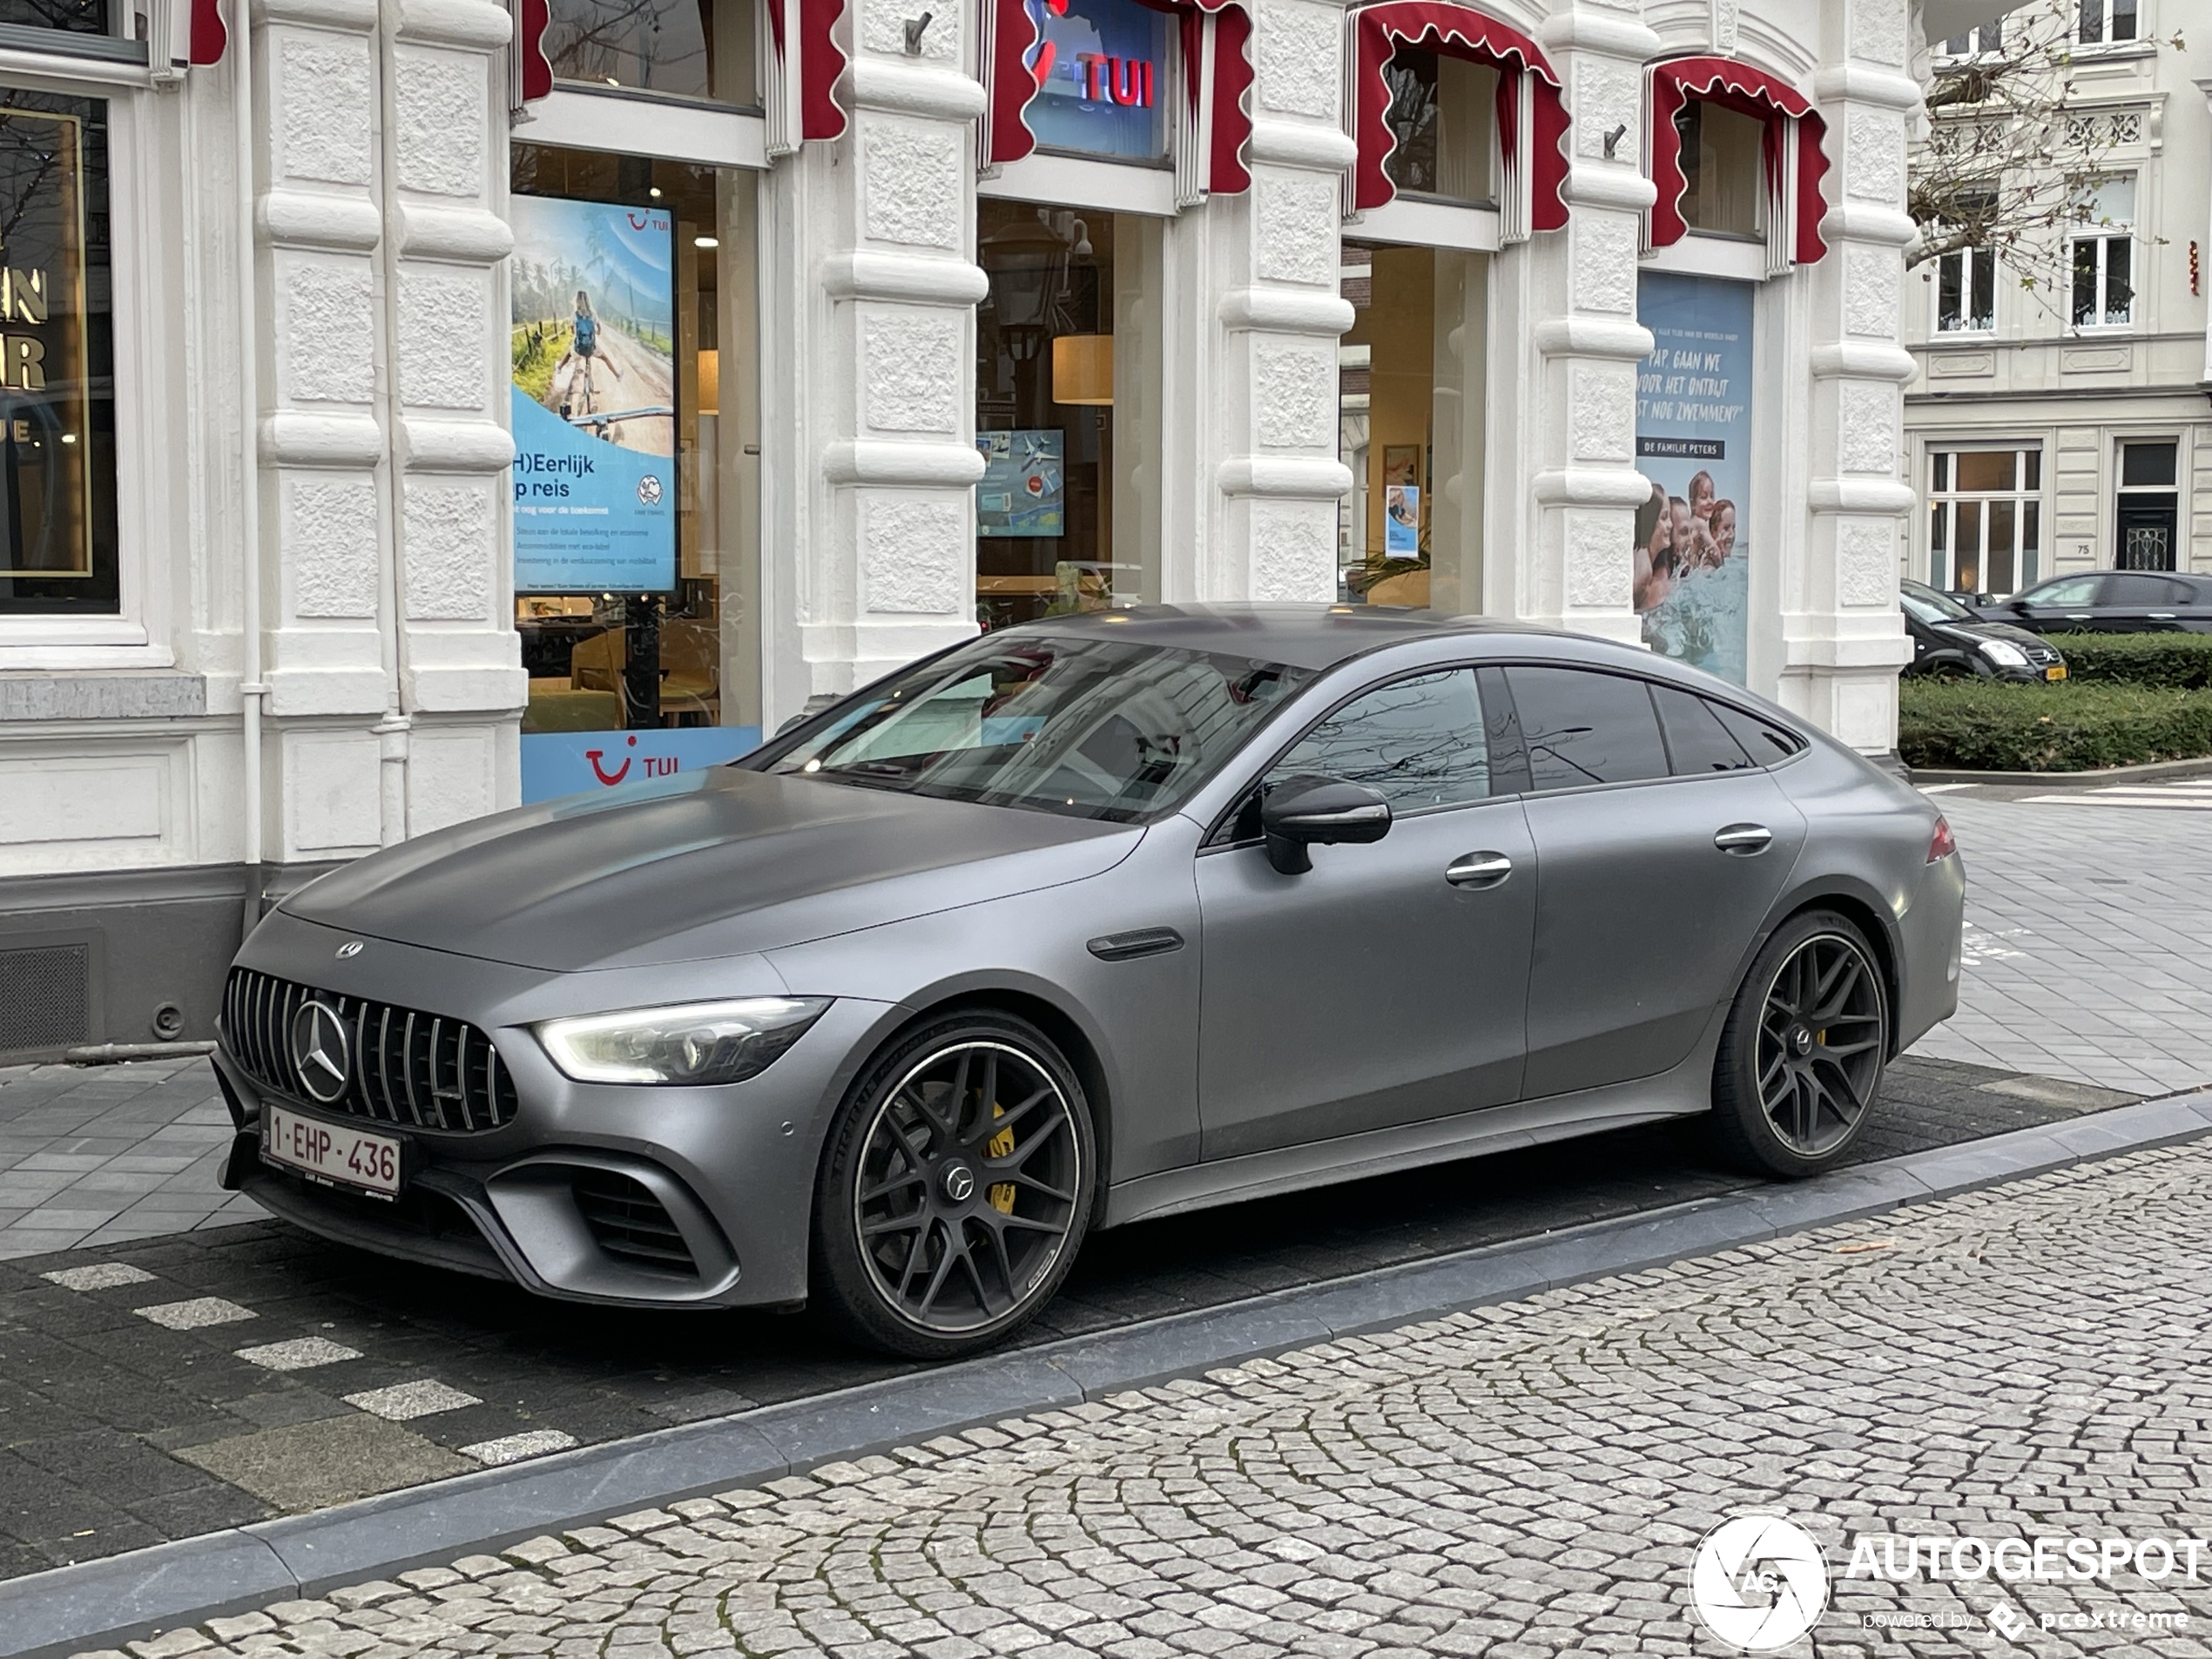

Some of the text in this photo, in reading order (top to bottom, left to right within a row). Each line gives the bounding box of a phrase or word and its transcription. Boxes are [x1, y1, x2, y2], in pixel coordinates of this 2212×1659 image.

[1076, 53, 1154, 109] TUI
[652, 219, 668, 231] TUI
[1649, 347, 1722, 372] PAP, GAAN WE
[1665, 376, 1687, 395] HET
[1689, 378, 1730, 398] ONTBIJT
[1651, 401, 1674, 421] NOG
[1644, 442, 1717, 455] DE FAMILIE PETERS
[532, 479, 570, 497] reis
[2078, 544, 2090, 555] 75
[643, 757, 678, 778] TUI
